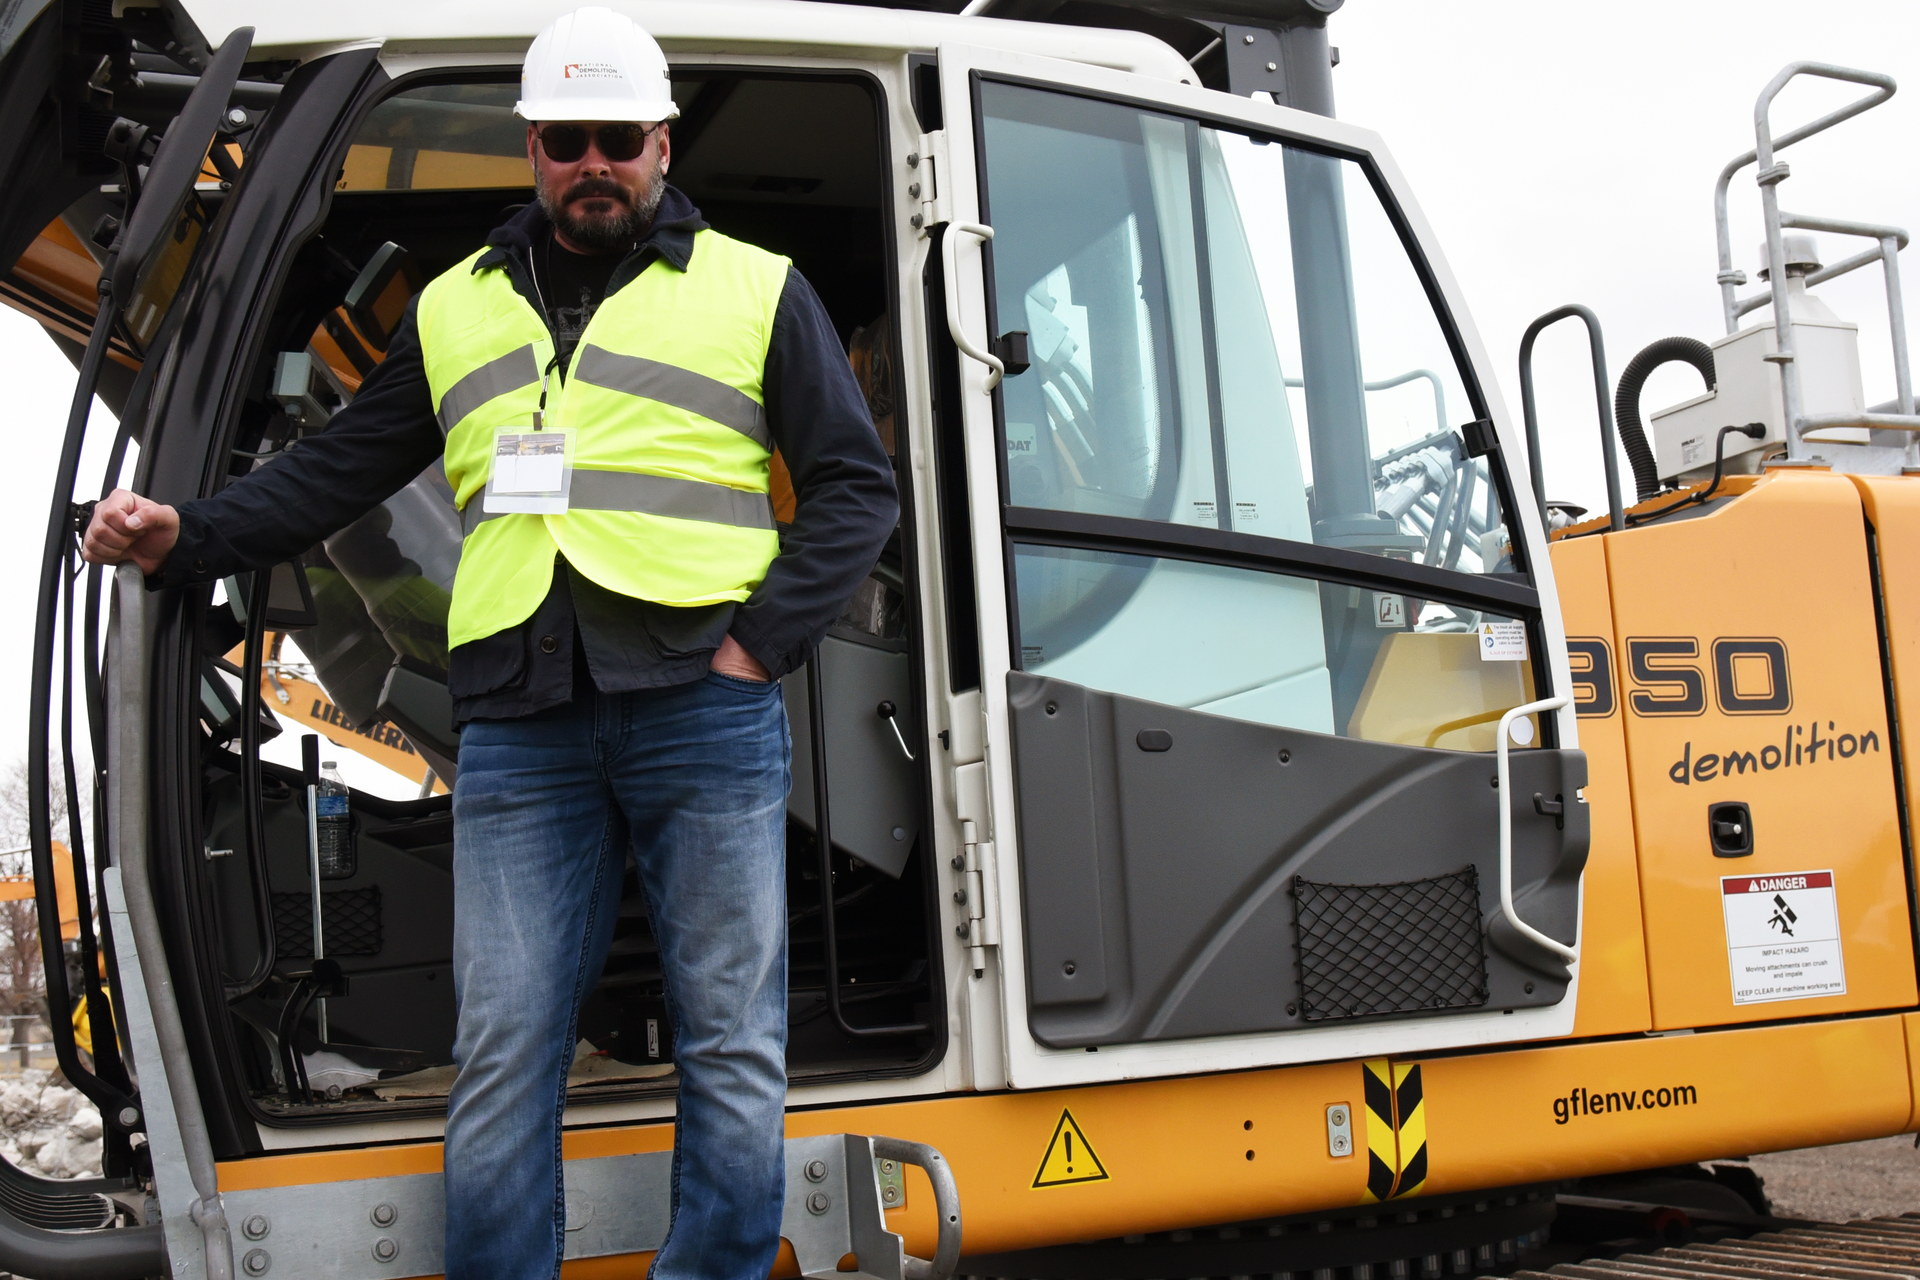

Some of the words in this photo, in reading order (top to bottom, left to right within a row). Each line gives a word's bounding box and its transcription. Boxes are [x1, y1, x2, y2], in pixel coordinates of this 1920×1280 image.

[1668, 720, 1880, 786] demolition
[1760, 877, 1807, 892] DANGER
[1762, 948, 1784, 956] IMPACT
[1785, 946, 1809, 954] HAZARD
[1745, 965, 1766, 973] Moving
[1767, 962, 1800, 971] attachments
[1813, 959, 1828, 967] crush
[1785, 970, 1803, 979] impale
[1737, 989, 1753, 997] KEEP
[1754, 987, 1775, 996] CLEAR
[1782, 984, 1806, 993] machine
[1806, 982, 1828, 991] working
[1553, 1085, 1697, 1125] gflenv.com
